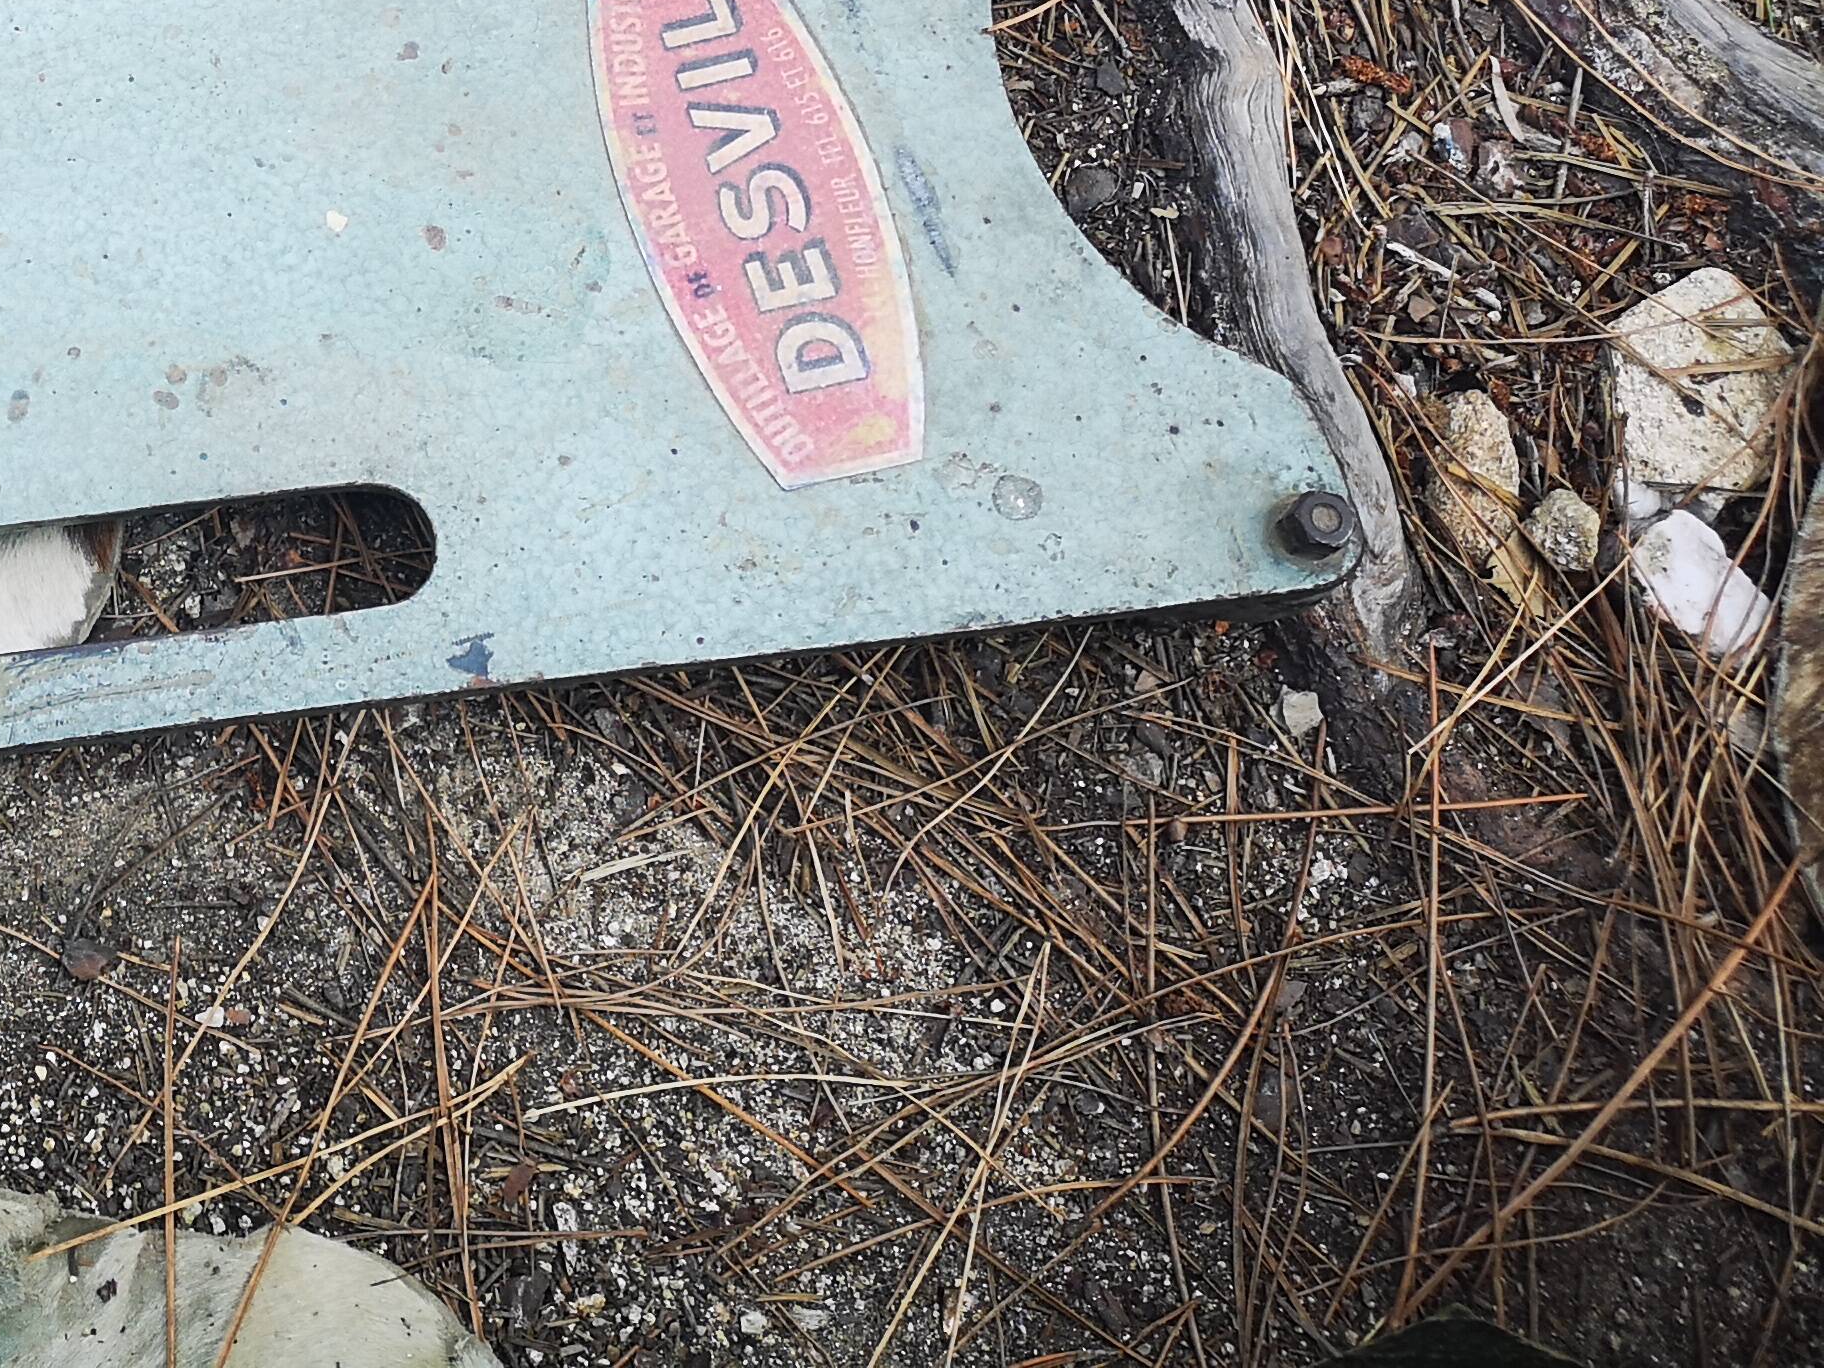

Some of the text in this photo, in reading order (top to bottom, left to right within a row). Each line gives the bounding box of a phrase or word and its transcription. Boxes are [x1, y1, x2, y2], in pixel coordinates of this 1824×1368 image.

[760, 27, 794, 62] 616
[780, 65, 809, 89] ET
[793, 91, 829, 125] 615
[627, 142, 697, 267] GARAGE
[694, 305, 815, 463] OUTILLAGE
